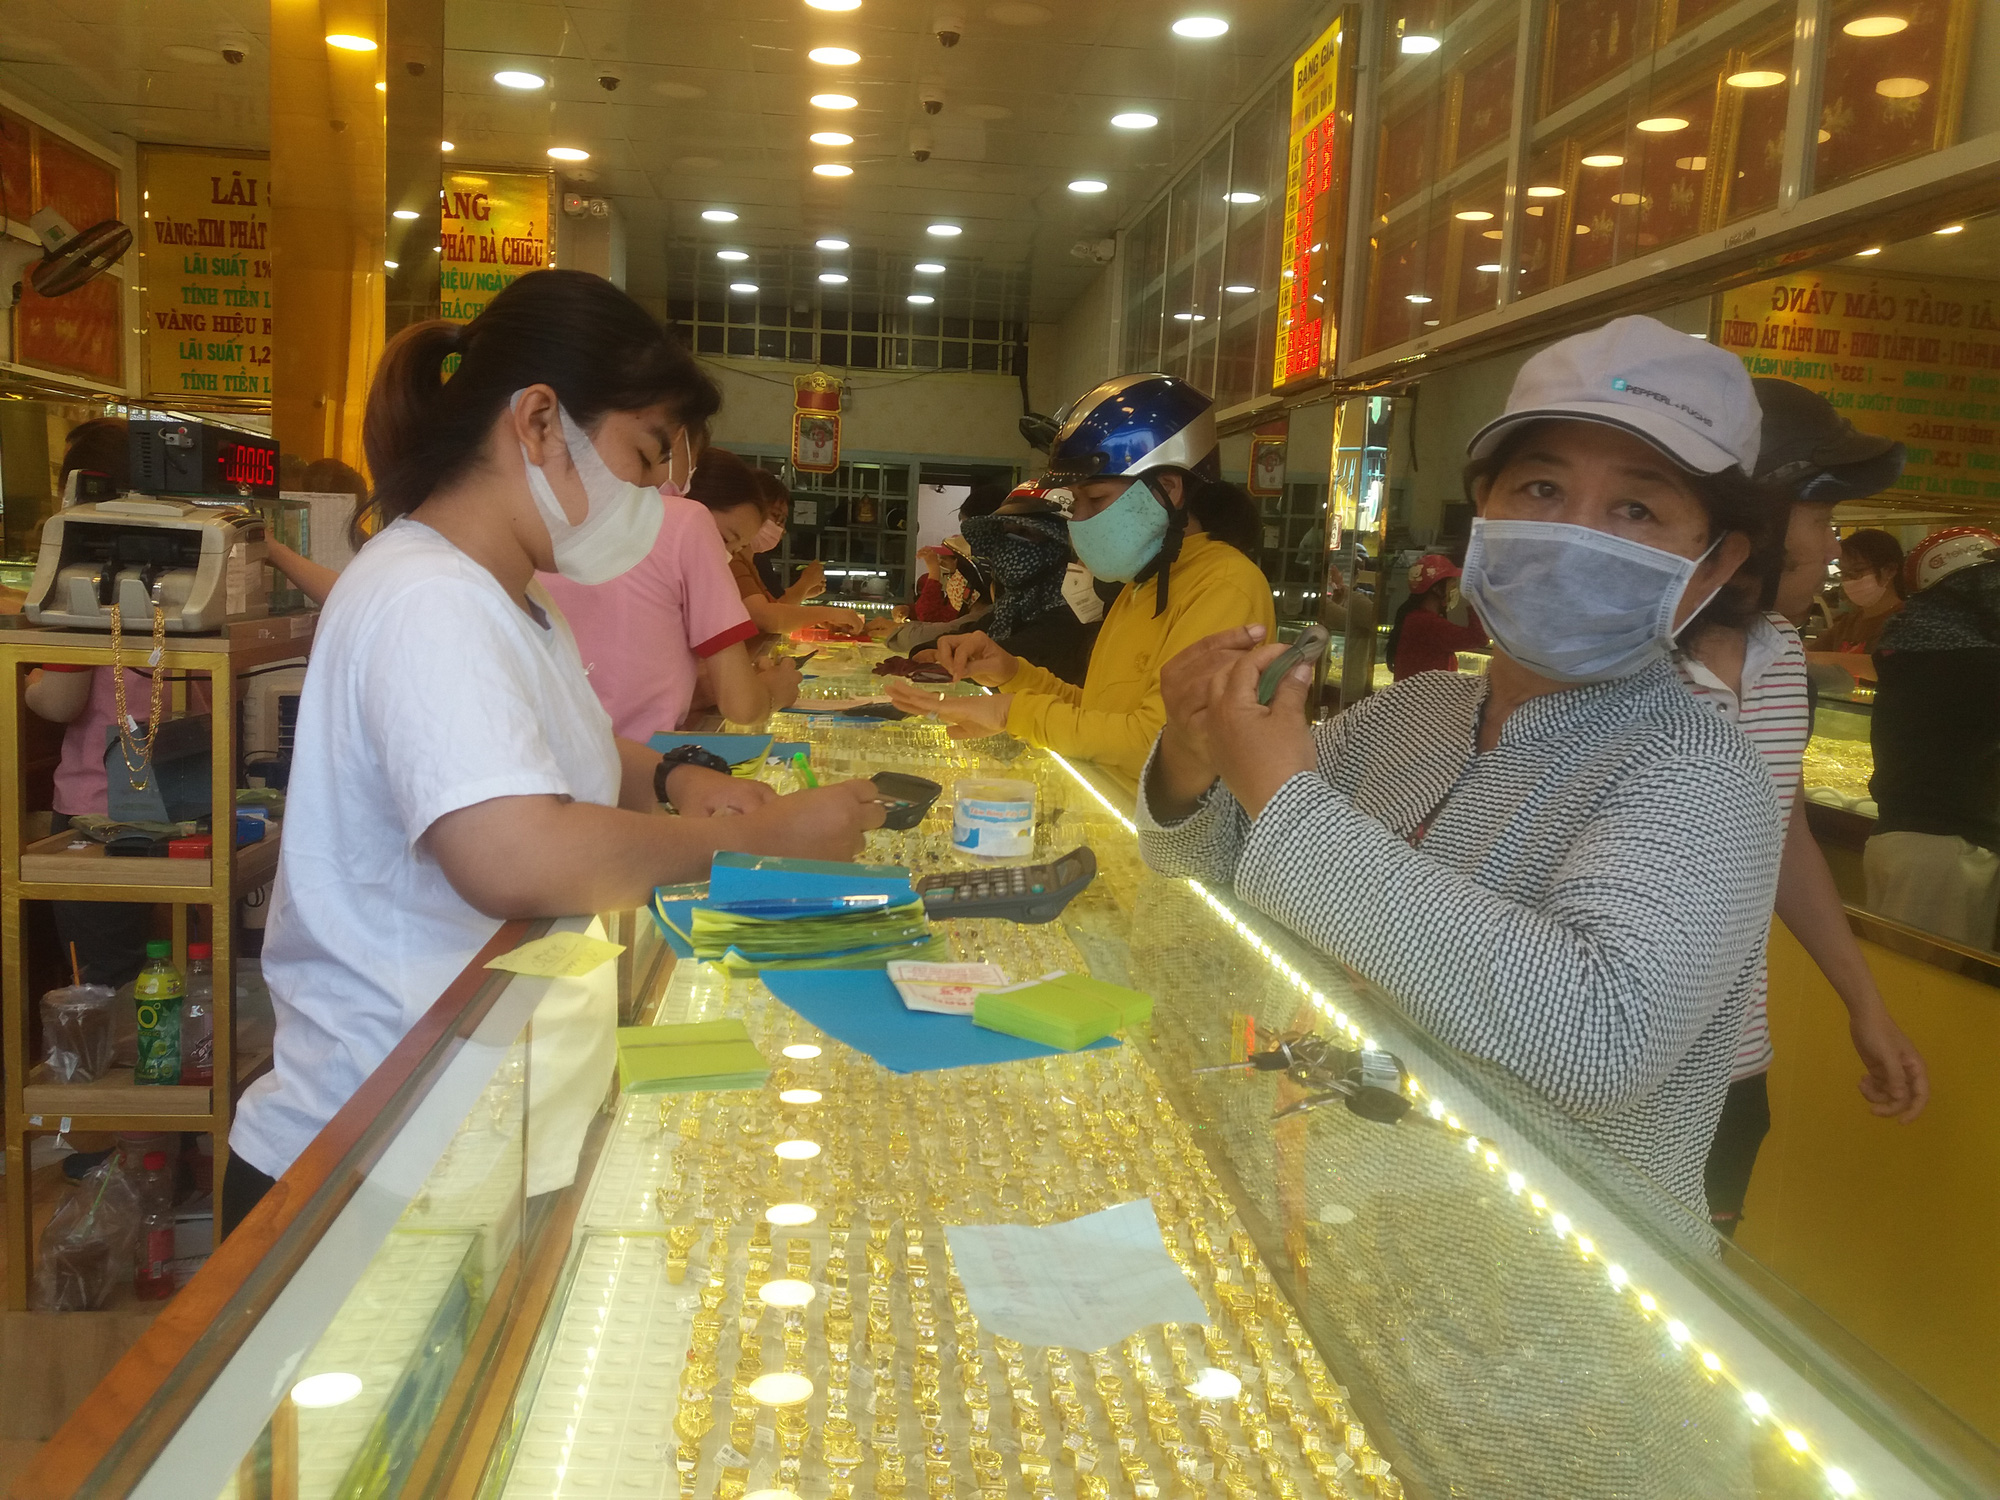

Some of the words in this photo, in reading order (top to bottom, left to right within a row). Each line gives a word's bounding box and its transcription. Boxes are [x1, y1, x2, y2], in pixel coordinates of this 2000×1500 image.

[1297, 53, 1319, 91] BẢNG
[211, 170, 258, 206] LÃI
[229, 213, 268, 250] PHÁT
[441, 226, 476, 262] PHÁT
[479, 228, 498, 264] BÀ
[501, 221, 544, 267] CHIỂU
[184, 252, 208, 275] LÃI
[211, 252, 249, 277] SUẤT
[181, 282, 219, 306] TÍNH
[223, 281, 260, 308] TIỀN
[155, 308, 207, 332] VÀNG
[212, 312, 257, 338] HIỆU
[180, 338, 203, 361] LÃI
[207, 338, 244, 362] SUẤT
[249, 345, 272, 367] 1,2
[181, 368, 219, 391] TÍNH
[222, 366, 260, 393] TIỀN
